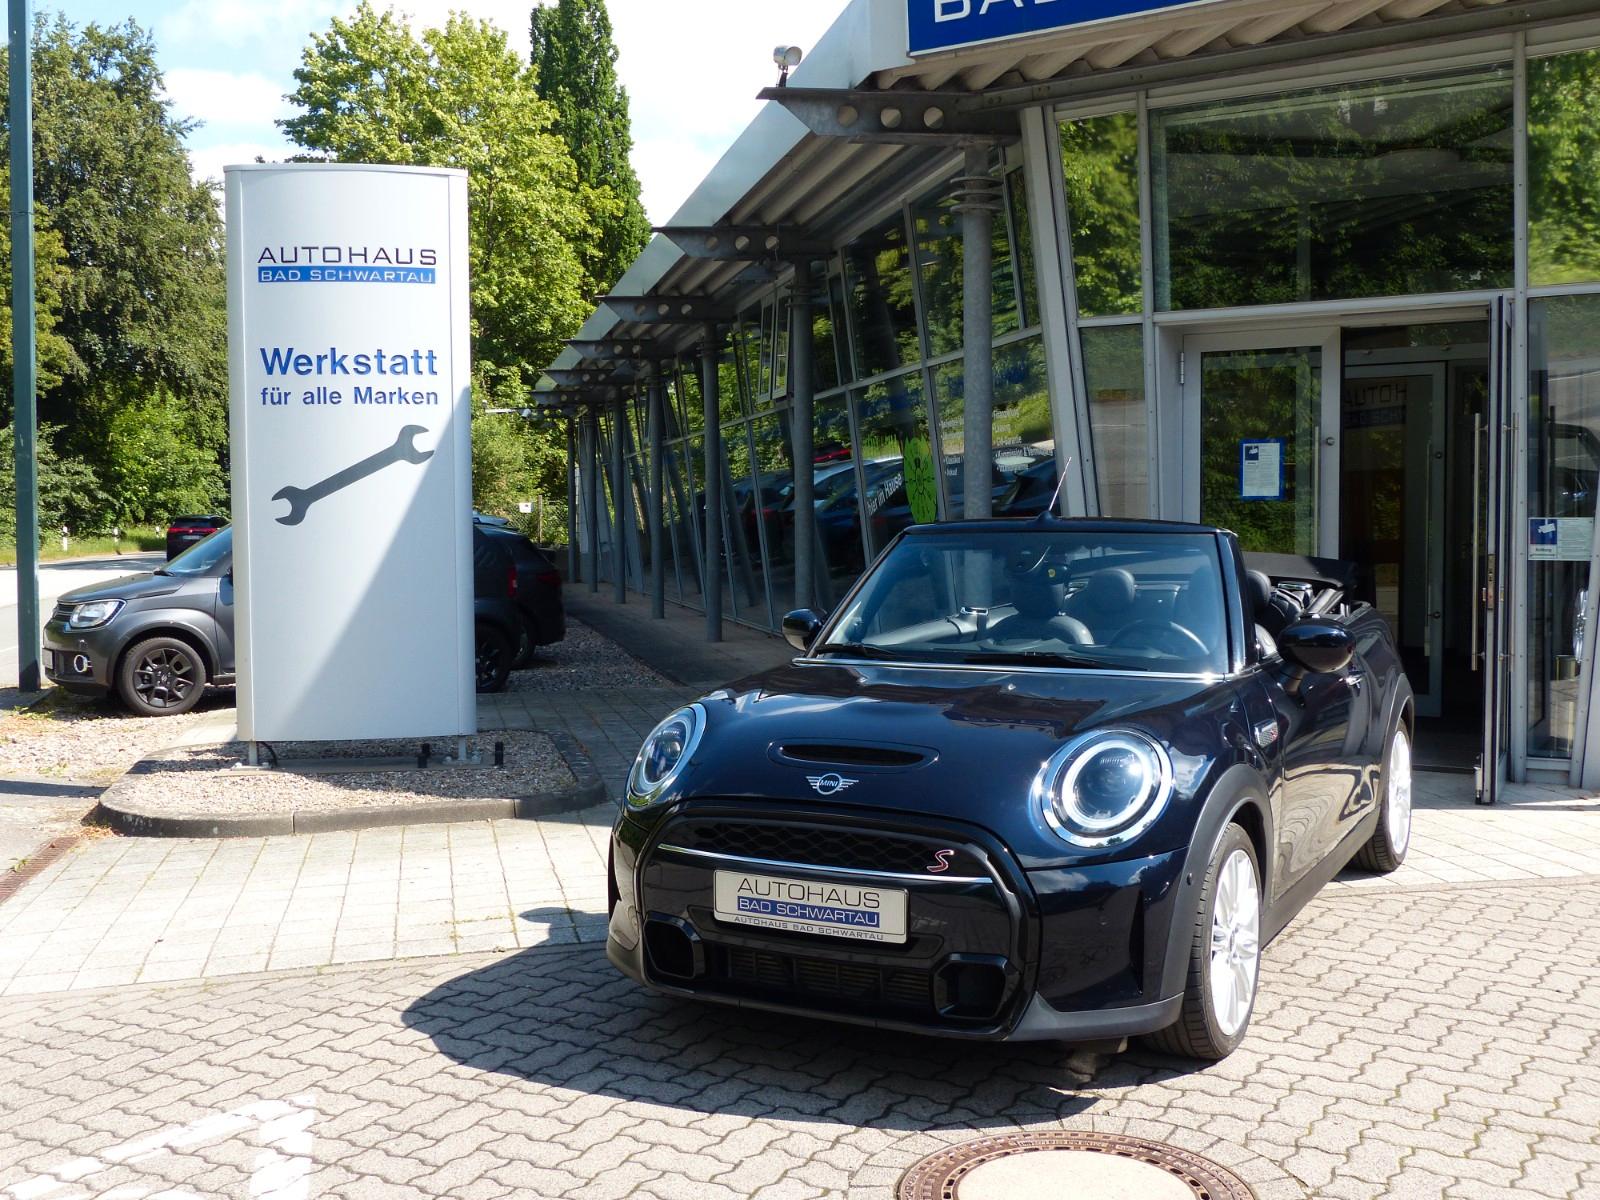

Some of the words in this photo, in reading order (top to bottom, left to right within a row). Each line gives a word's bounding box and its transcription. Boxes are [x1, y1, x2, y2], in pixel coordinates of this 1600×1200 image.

[257, 246, 438, 266] AUTOHAUS
[260, 269, 301, 282] BAD
[310, 269, 433, 283] SCHWARTAU
[259, 347, 439, 376] Werkstatt
[260, 387, 292, 406] für
[302, 387, 342, 405] alle
[353, 387, 439, 405] Marken
[819, 779, 839, 787] MINI
[926, 849, 955, 873] S
[737, 877, 881, 909] AUTOHAUS
[739, 898, 772, 913] BAD
[776, 902, 879, 926] SCHWARTAU
[734, 915, 788, 929] AUTOHAUS
[792, 923, 814, 934] BAD
[817, 926, 885, 941] SCHWARTAU
